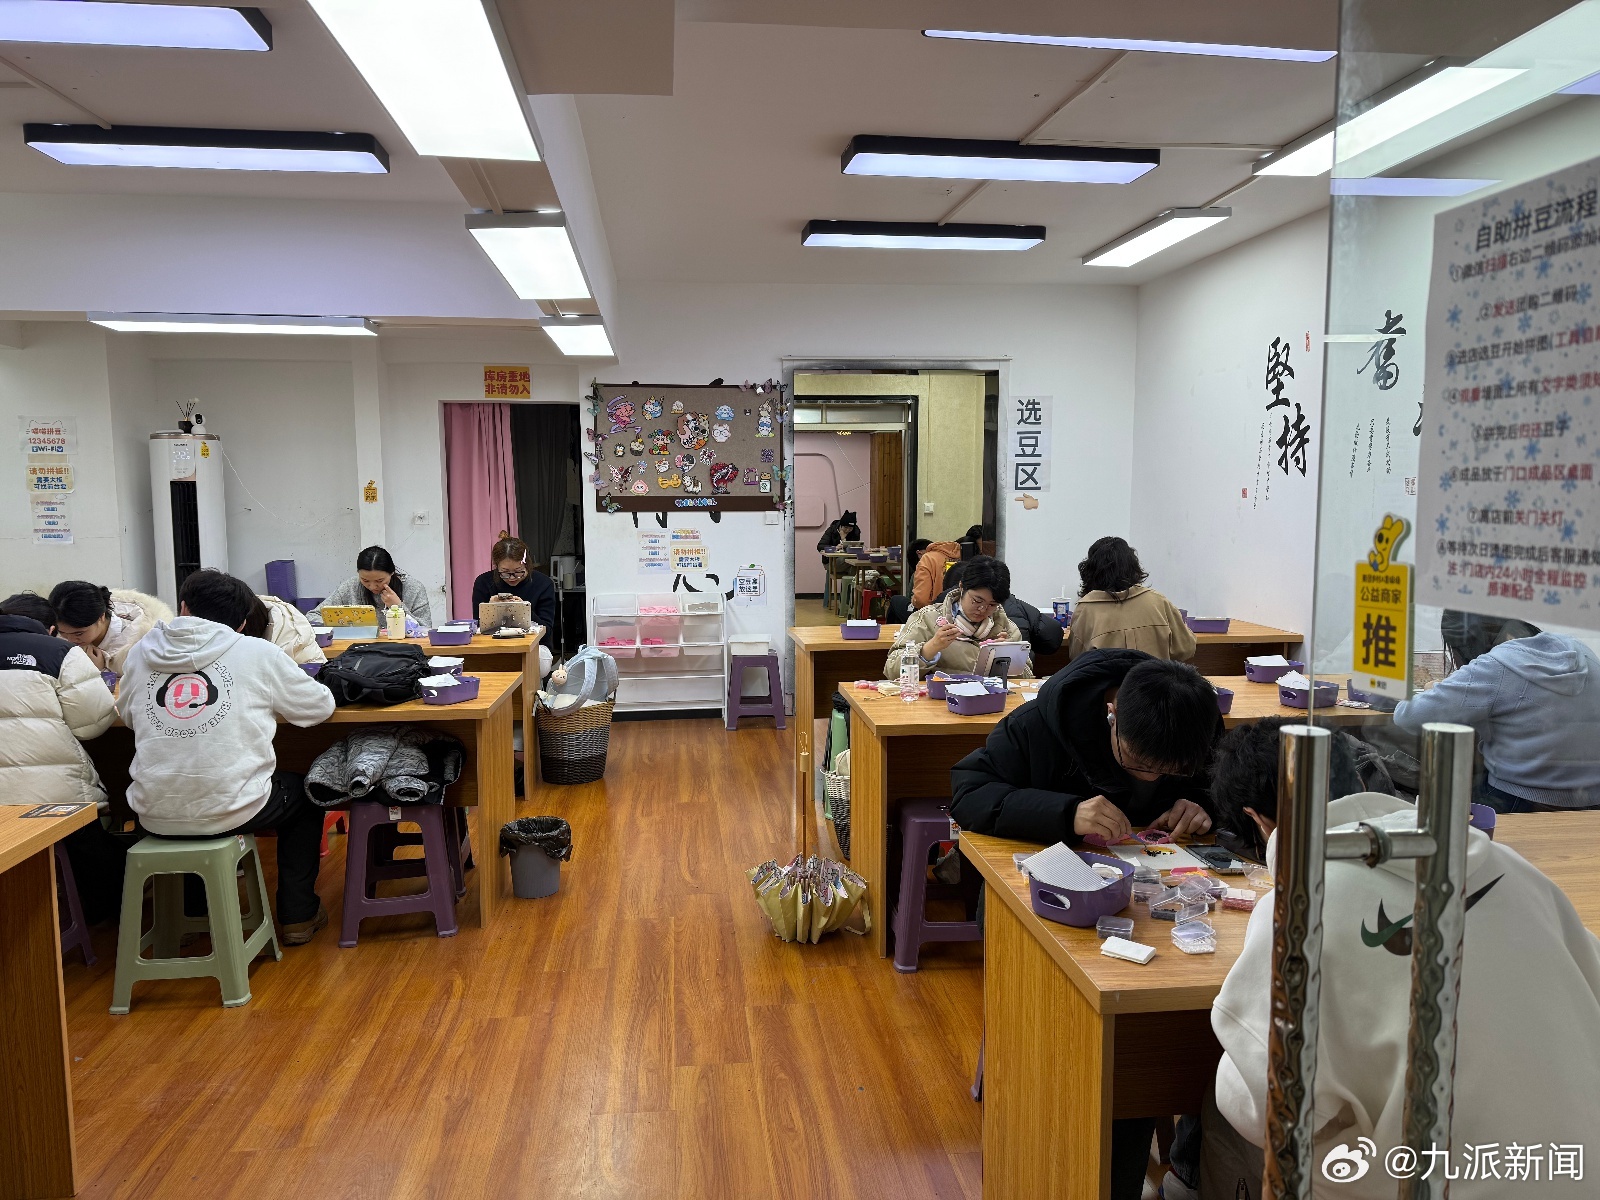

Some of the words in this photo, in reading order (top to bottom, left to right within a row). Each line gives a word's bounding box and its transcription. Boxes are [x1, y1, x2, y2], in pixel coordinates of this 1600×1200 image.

[1475, 190, 1598, 252] 自助拼豆流程
[484, 370, 531, 383] 库房重地
[485, 383, 531, 395] 非请勿入
[28, 437, 66, 445] 12345678
[1015, 399, 1042, 490] 选豆区
[1360, 586, 1402, 604] 公益商家
[1486, 580, 1535, 601] 感谢配合
[1362, 613, 1397, 668] 推
